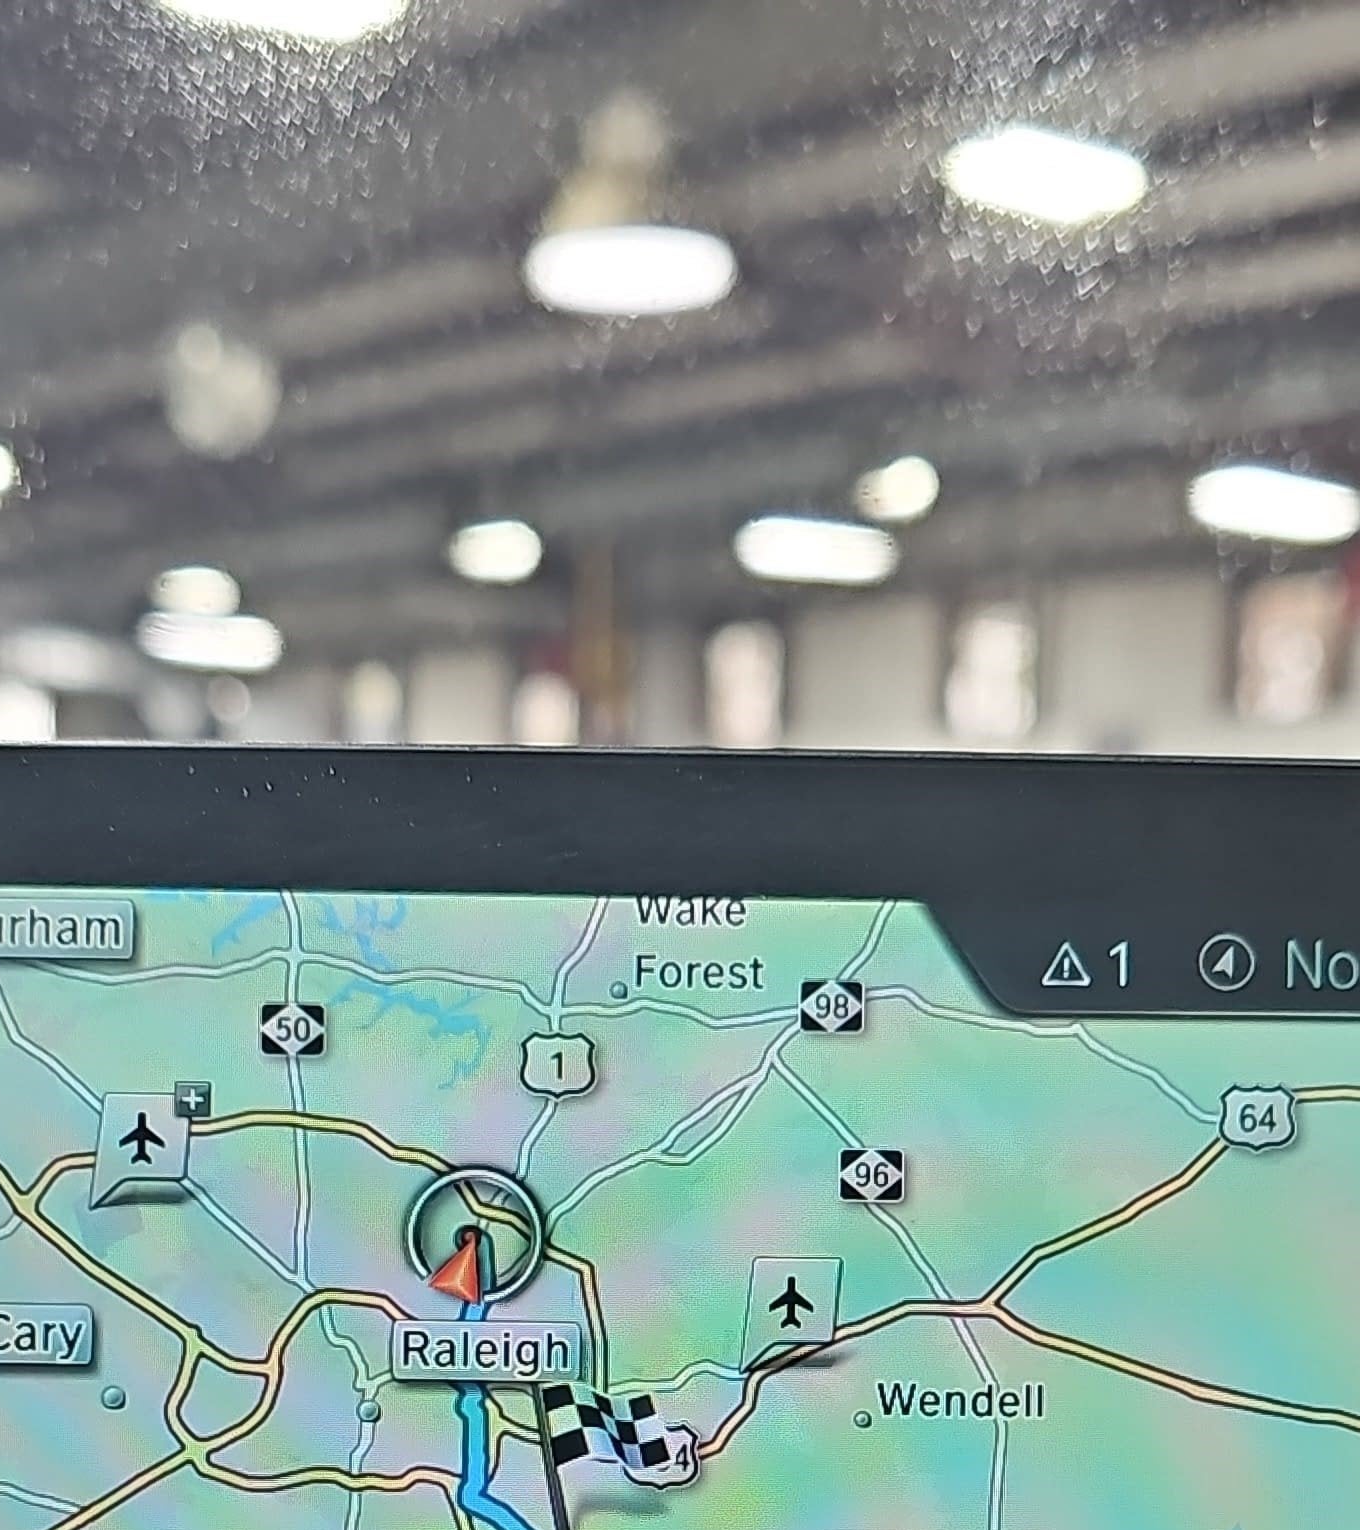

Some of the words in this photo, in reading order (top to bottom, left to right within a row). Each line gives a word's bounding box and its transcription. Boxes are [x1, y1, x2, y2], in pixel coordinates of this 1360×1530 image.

[636, 954, 764, 989] Forest
[1109, 941, 1129, 987] 1
[1287, 942, 1359, 990] No
[815, 994, 848, 1020] 98
[276, 1017, 310, 1043] 50
[549, 1052, 564, 1079] 1
[1240, 1104, 1276, 1132] 64
[855, 1162, 889, 1188] 96
[403, 1330, 570, 1373] Raleigh
[878, 1384, 1043, 1418] Wendell
